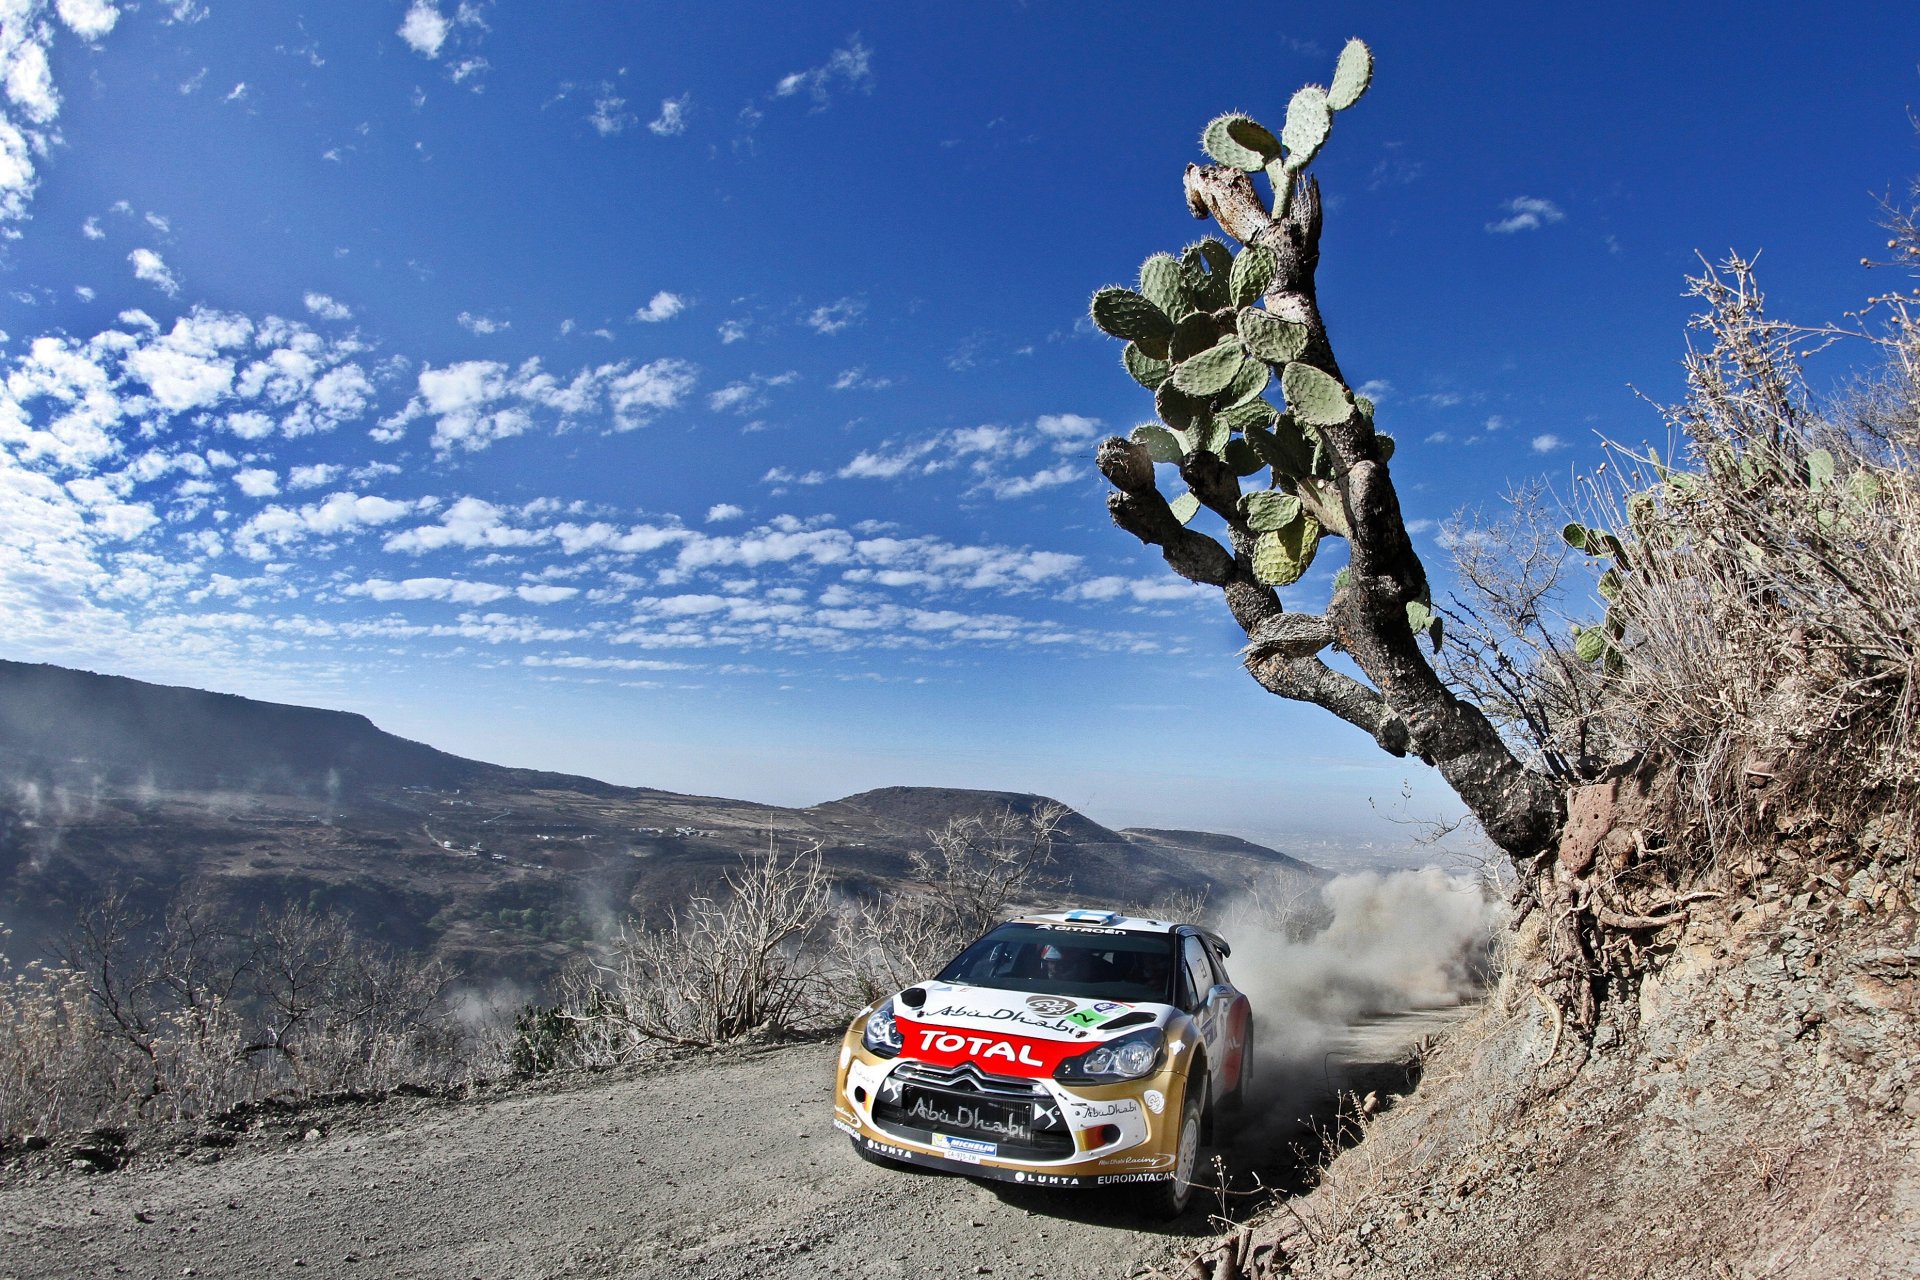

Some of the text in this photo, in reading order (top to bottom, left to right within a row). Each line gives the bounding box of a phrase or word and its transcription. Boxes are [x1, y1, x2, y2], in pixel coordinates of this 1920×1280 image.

[1073, 1012, 1095, 1023] 2
[919, 1029, 1043, 1067] TOTAL
[874, 1142, 912, 1158] LUHTA
[950, 1139, 996, 1153] MICHELIN
[1027, 1174, 1080, 1185] LUHTA
